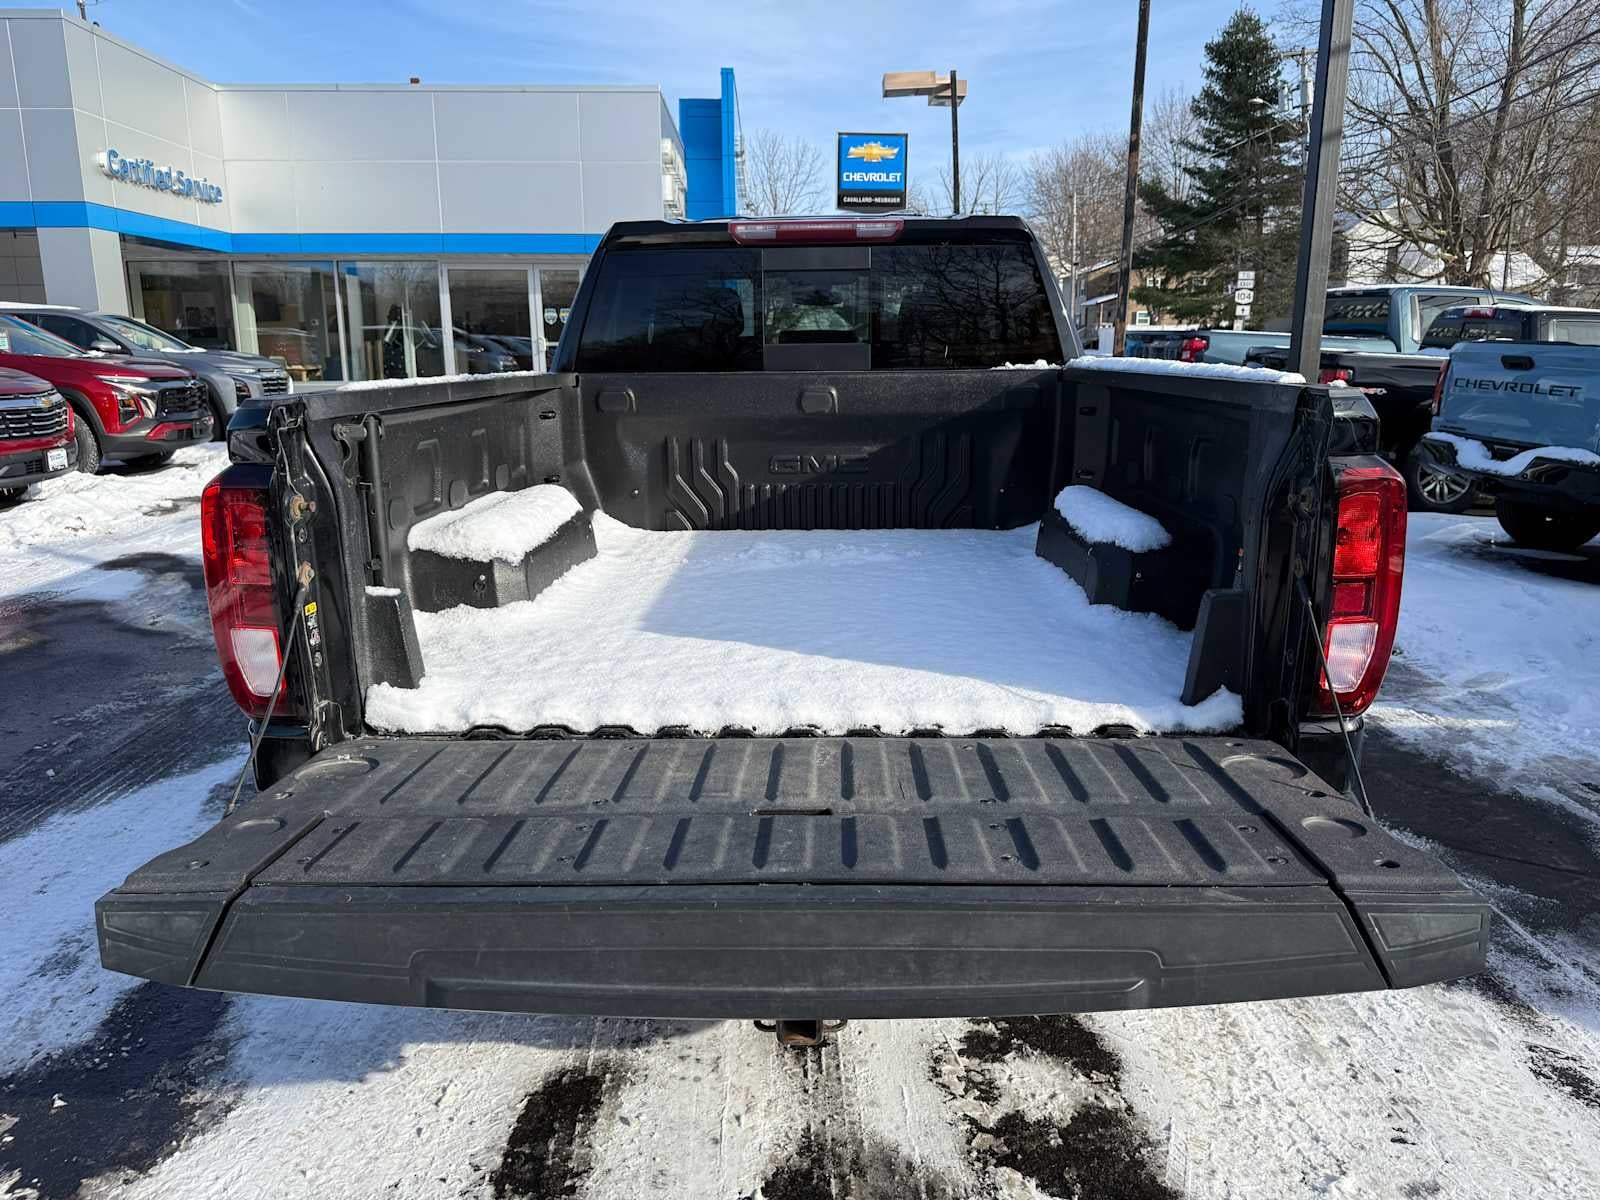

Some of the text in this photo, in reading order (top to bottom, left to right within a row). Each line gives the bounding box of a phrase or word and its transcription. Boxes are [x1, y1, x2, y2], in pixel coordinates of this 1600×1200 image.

[107, 148, 223, 204] Certified Service
[842, 171, 902, 182] CHEVROLET
[1237, 292, 1252, 301] 104
[1454, 377, 1583, 398] CHEVROLET
[768, 454, 869, 475] GMC
